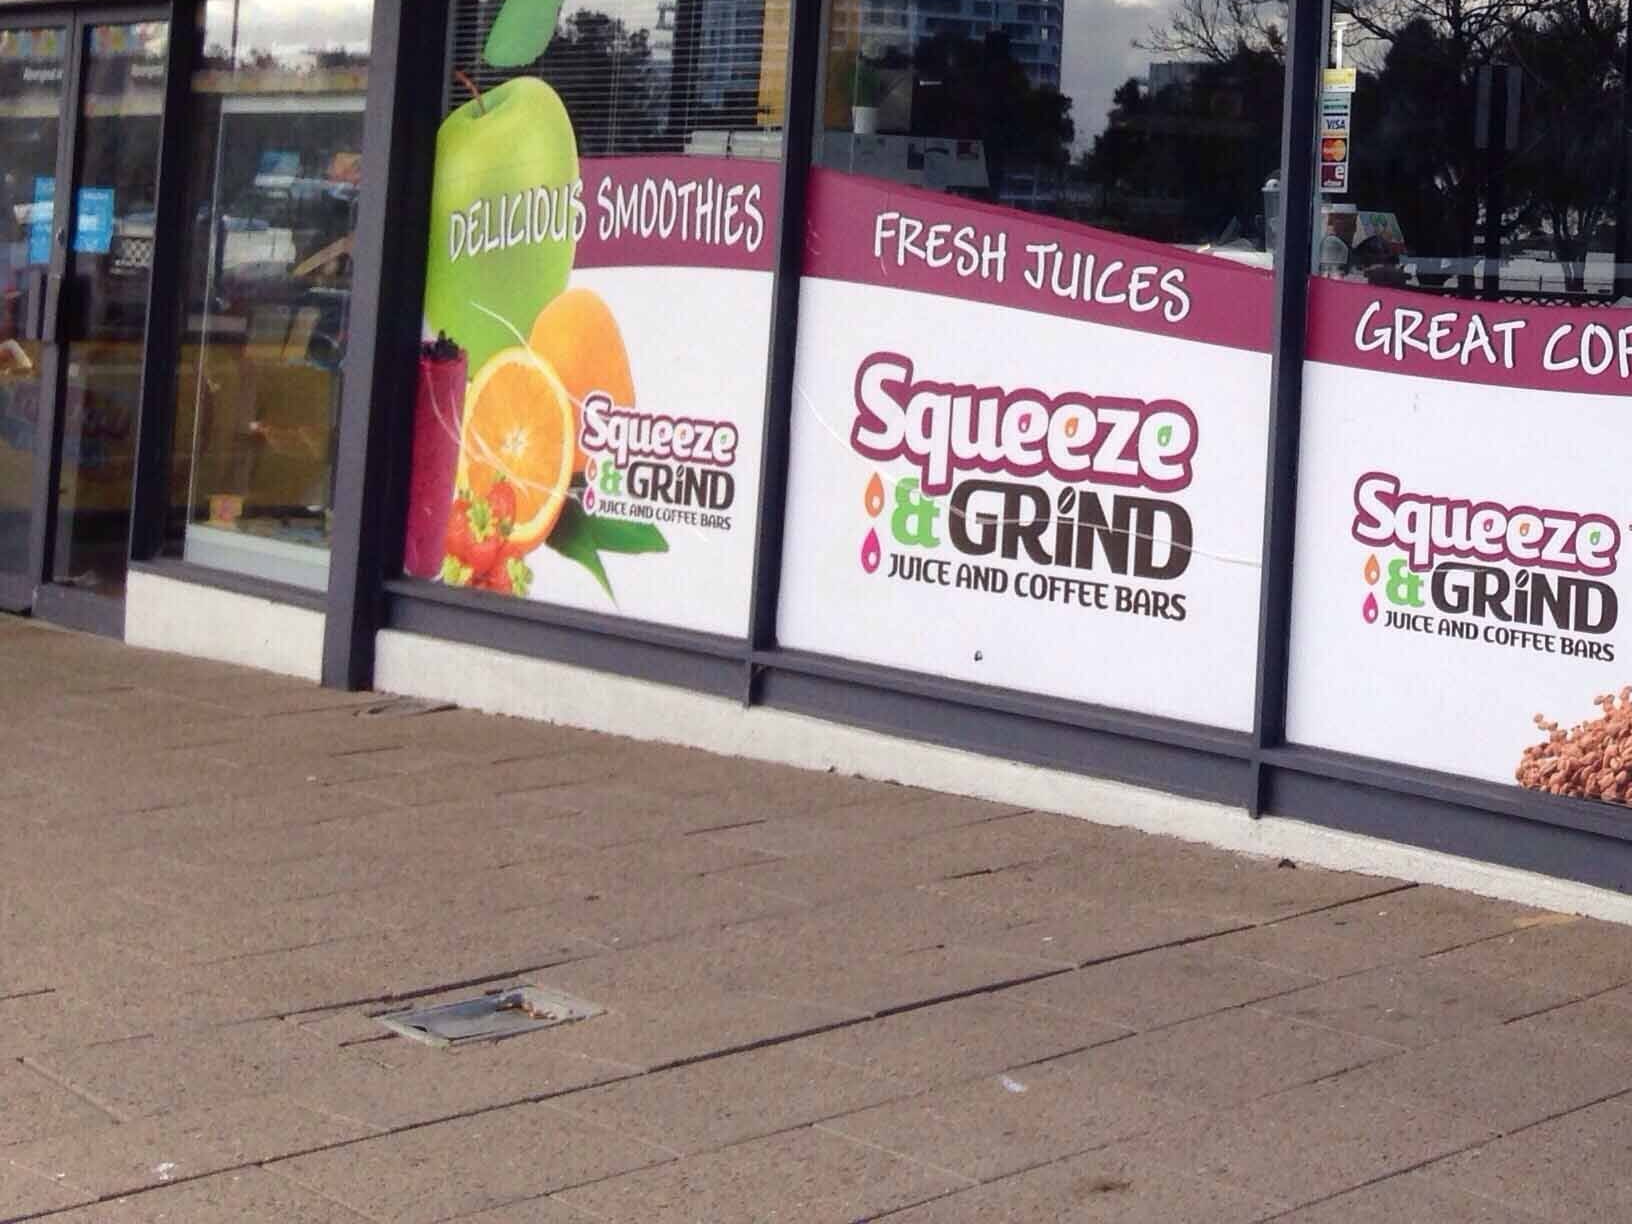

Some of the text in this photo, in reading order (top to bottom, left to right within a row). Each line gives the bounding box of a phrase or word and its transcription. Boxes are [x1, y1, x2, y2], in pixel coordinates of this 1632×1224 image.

[1327, 119, 1345, 130] VISA
[449, 176, 764, 262] DELICIOUS SMOOTHIES
[874, 213, 1191, 322] FRESH JUICES
[1354, 301, 1526, 370] GREAT
[581, 394, 738, 469] Squeeze
[851, 352, 1198, 496] Squeeze
[600, 458, 623, 495] &
[600, 500, 732, 531] JUICE AND COFFEE BARS
[891, 477, 941, 549] &
[1352, 472, 1621, 576] Squeeze
[888, 553, 1187, 622] JUICE AND COFFEE BARS
[1385, 557, 1425, 608] &
[1384, 609, 1616, 663] JUICE AND COFFEE BARS
